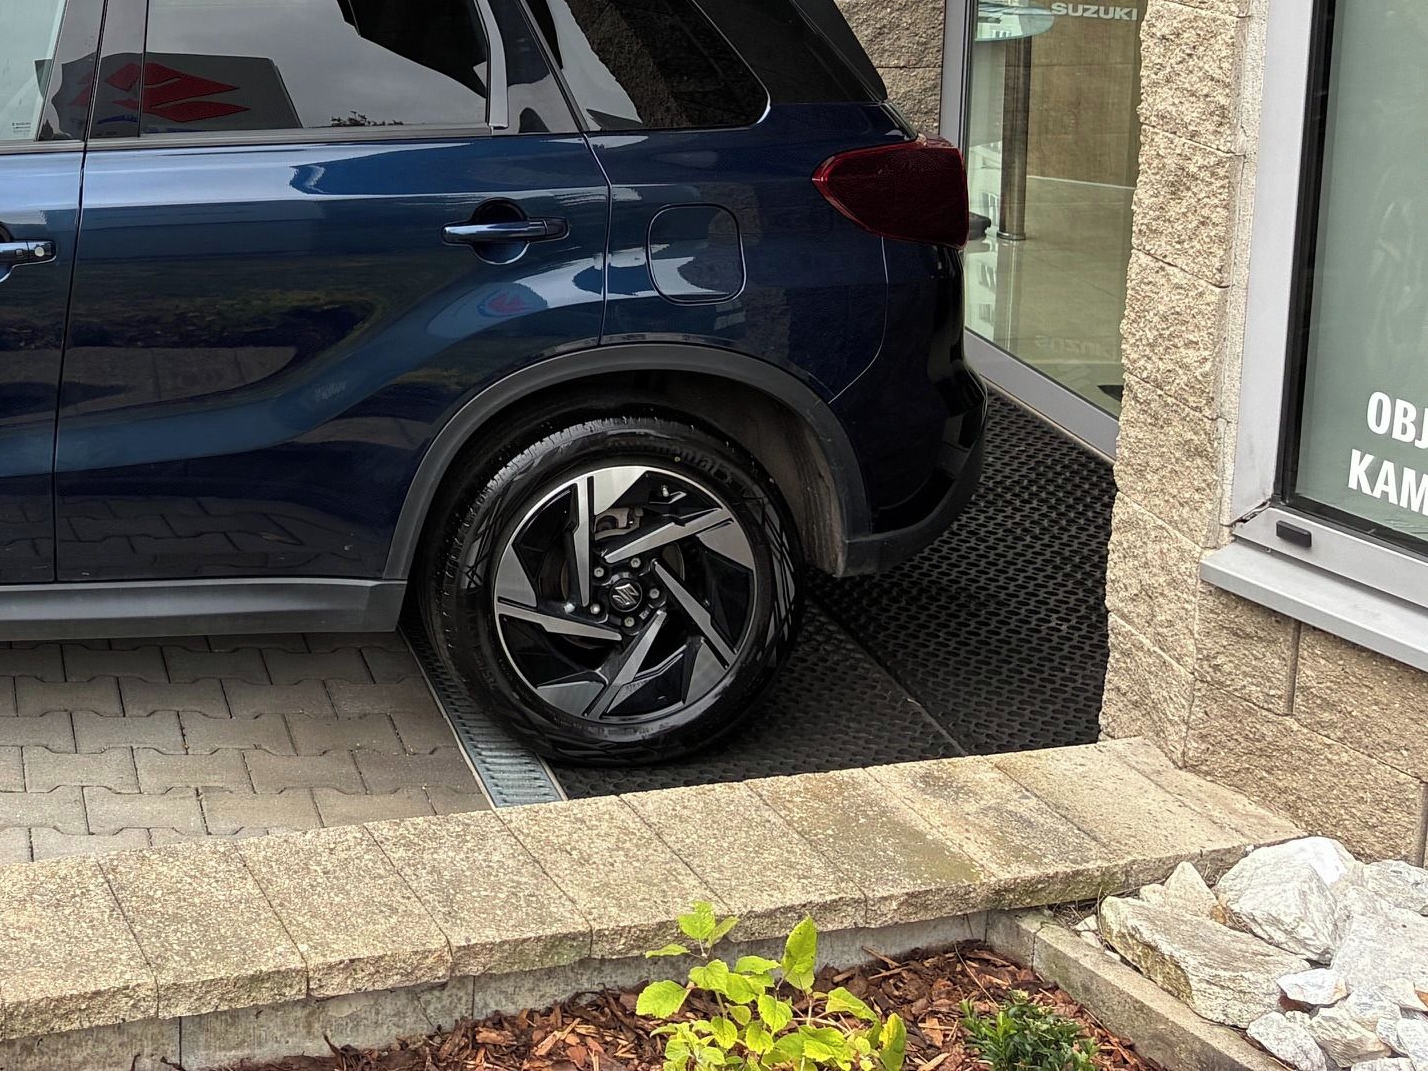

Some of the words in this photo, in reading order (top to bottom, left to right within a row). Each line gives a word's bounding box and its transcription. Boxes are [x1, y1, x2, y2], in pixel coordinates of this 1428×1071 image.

[1051, 2, 1138, 21] SUZUKI
[1367, 391, 1428, 449] OBJ
[1348, 448, 1428, 517] KAM
